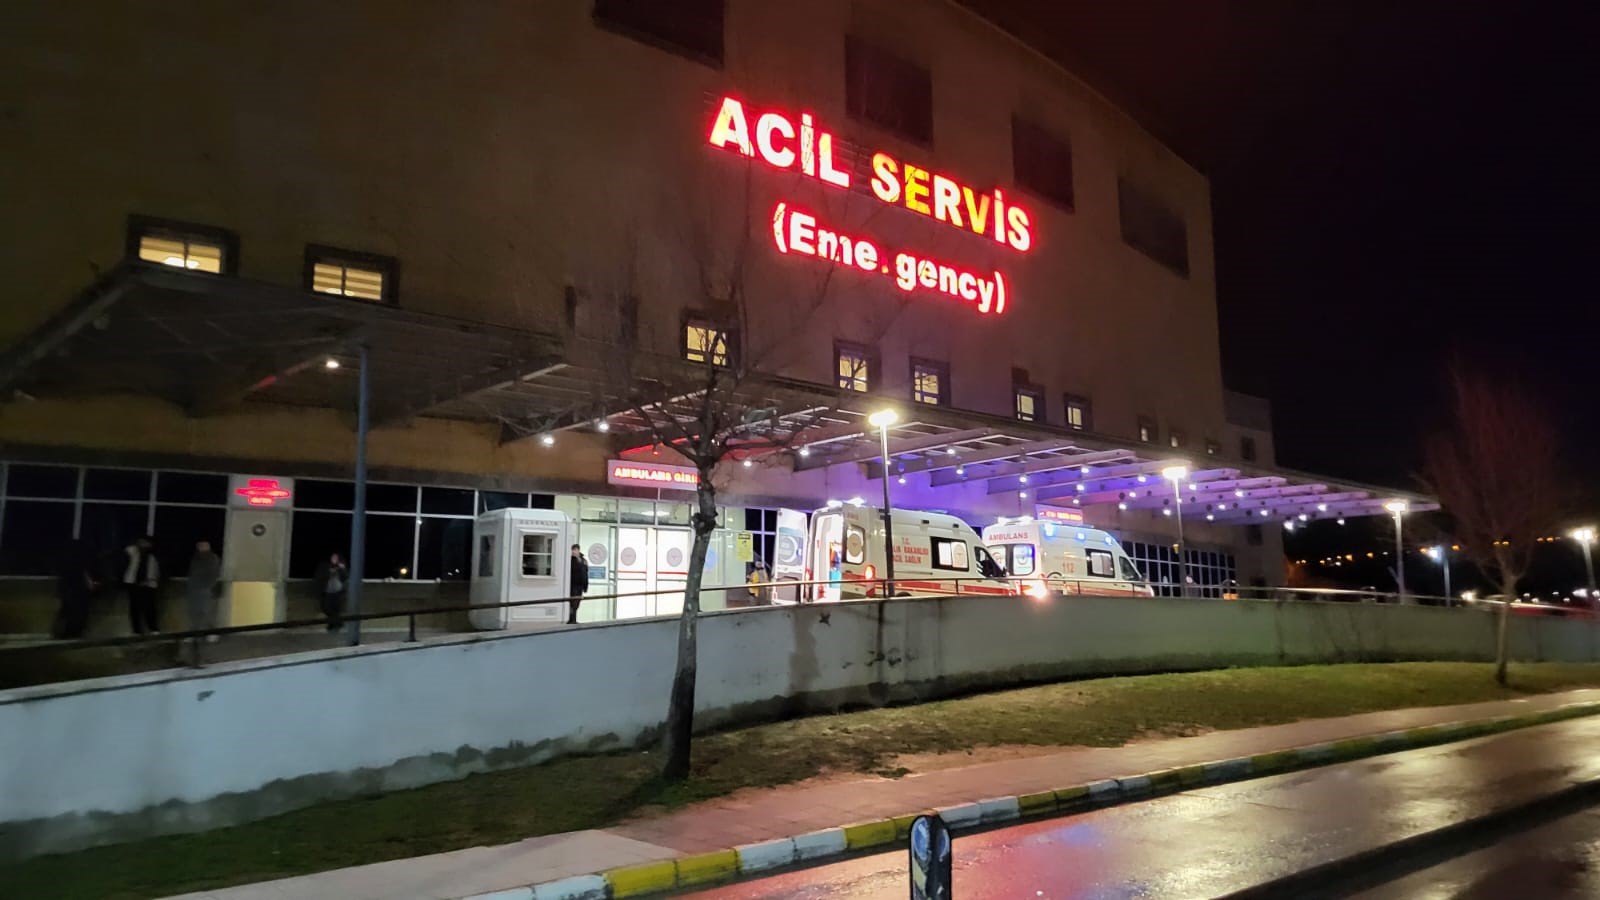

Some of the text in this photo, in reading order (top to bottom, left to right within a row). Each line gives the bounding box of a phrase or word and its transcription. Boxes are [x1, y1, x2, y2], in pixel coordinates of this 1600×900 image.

[709, 96, 1031, 252] ACİL SERVİS
[614, 467, 672, 482] AMBULANS
[989, 532, 1028, 541] AMBULANS
[1063, 562, 1075, 574] 112
